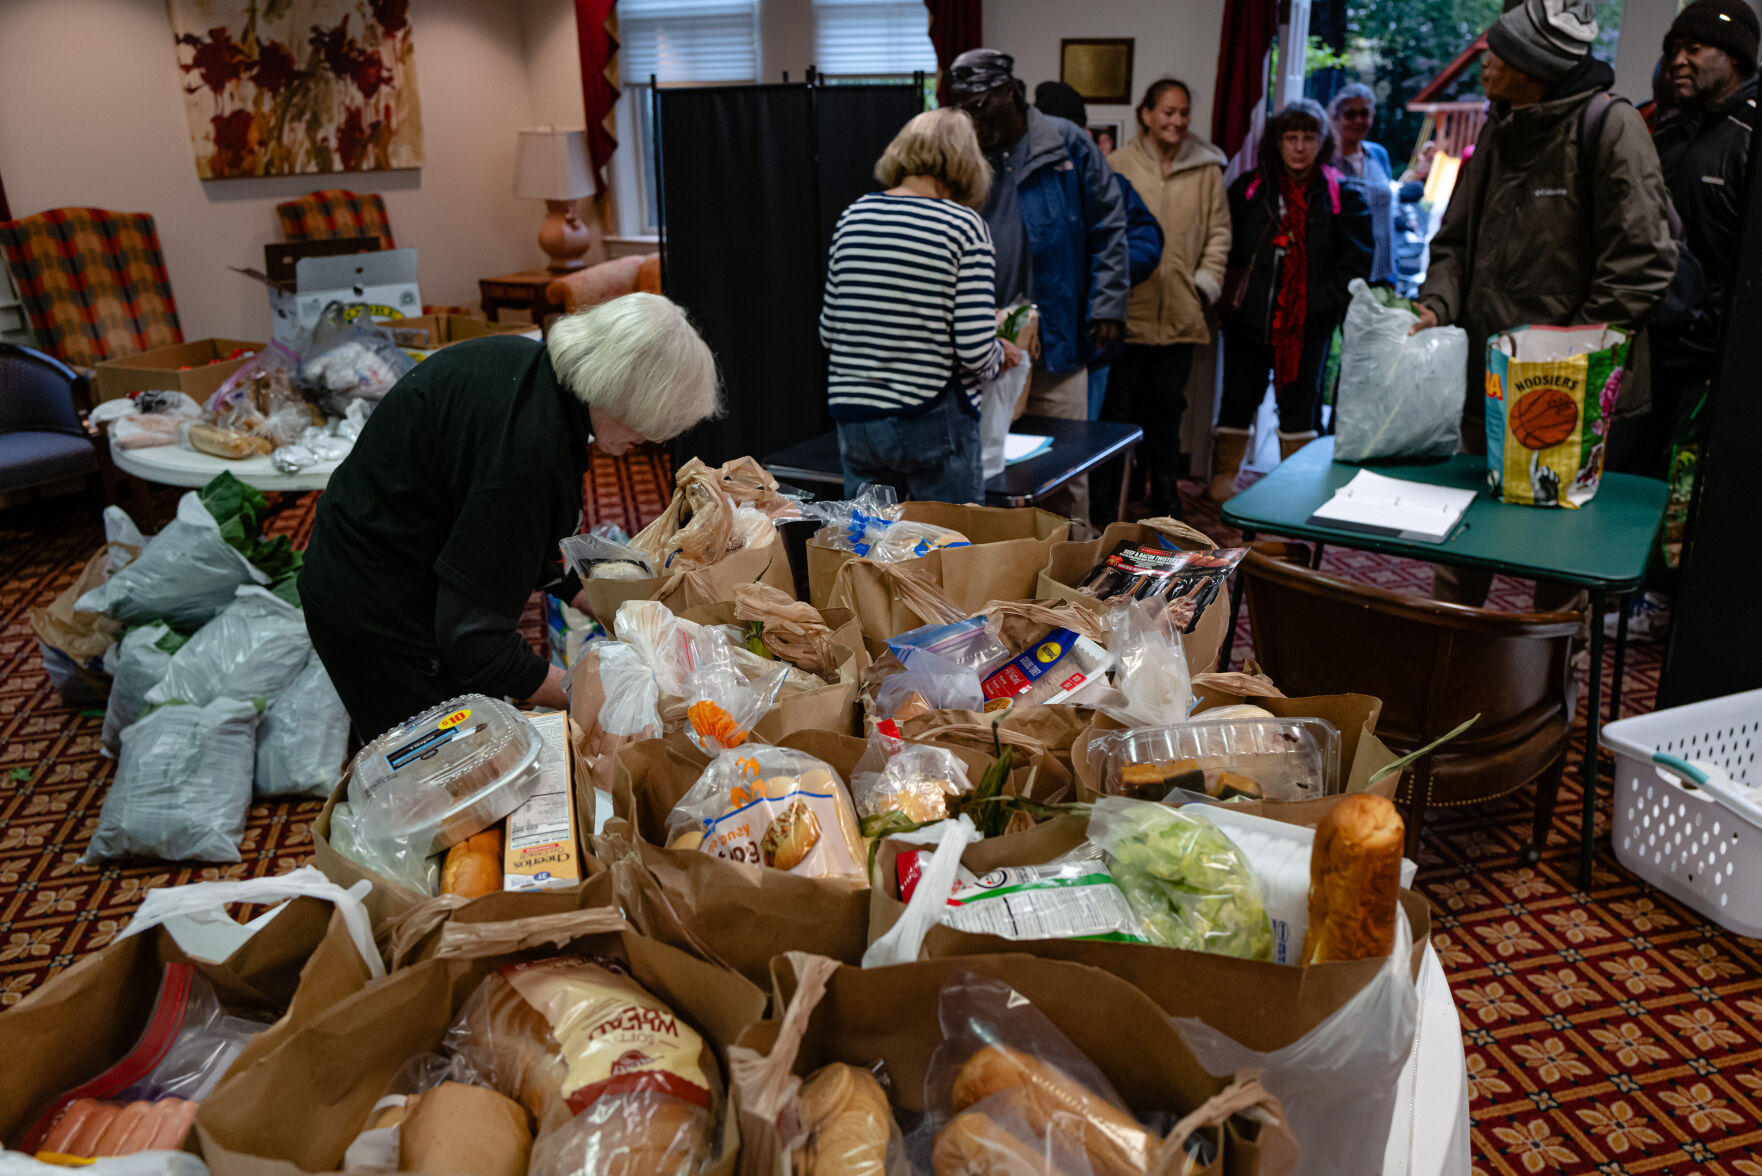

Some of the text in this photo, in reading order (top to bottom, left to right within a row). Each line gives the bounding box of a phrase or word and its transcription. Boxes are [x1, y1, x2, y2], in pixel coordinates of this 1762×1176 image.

[1514, 374, 1579, 393] HOOSIERS
[441, 711, 466, 727] $10
[513, 853, 570, 868] Cheerios
[588, 1006, 679, 1041] WHEAT
